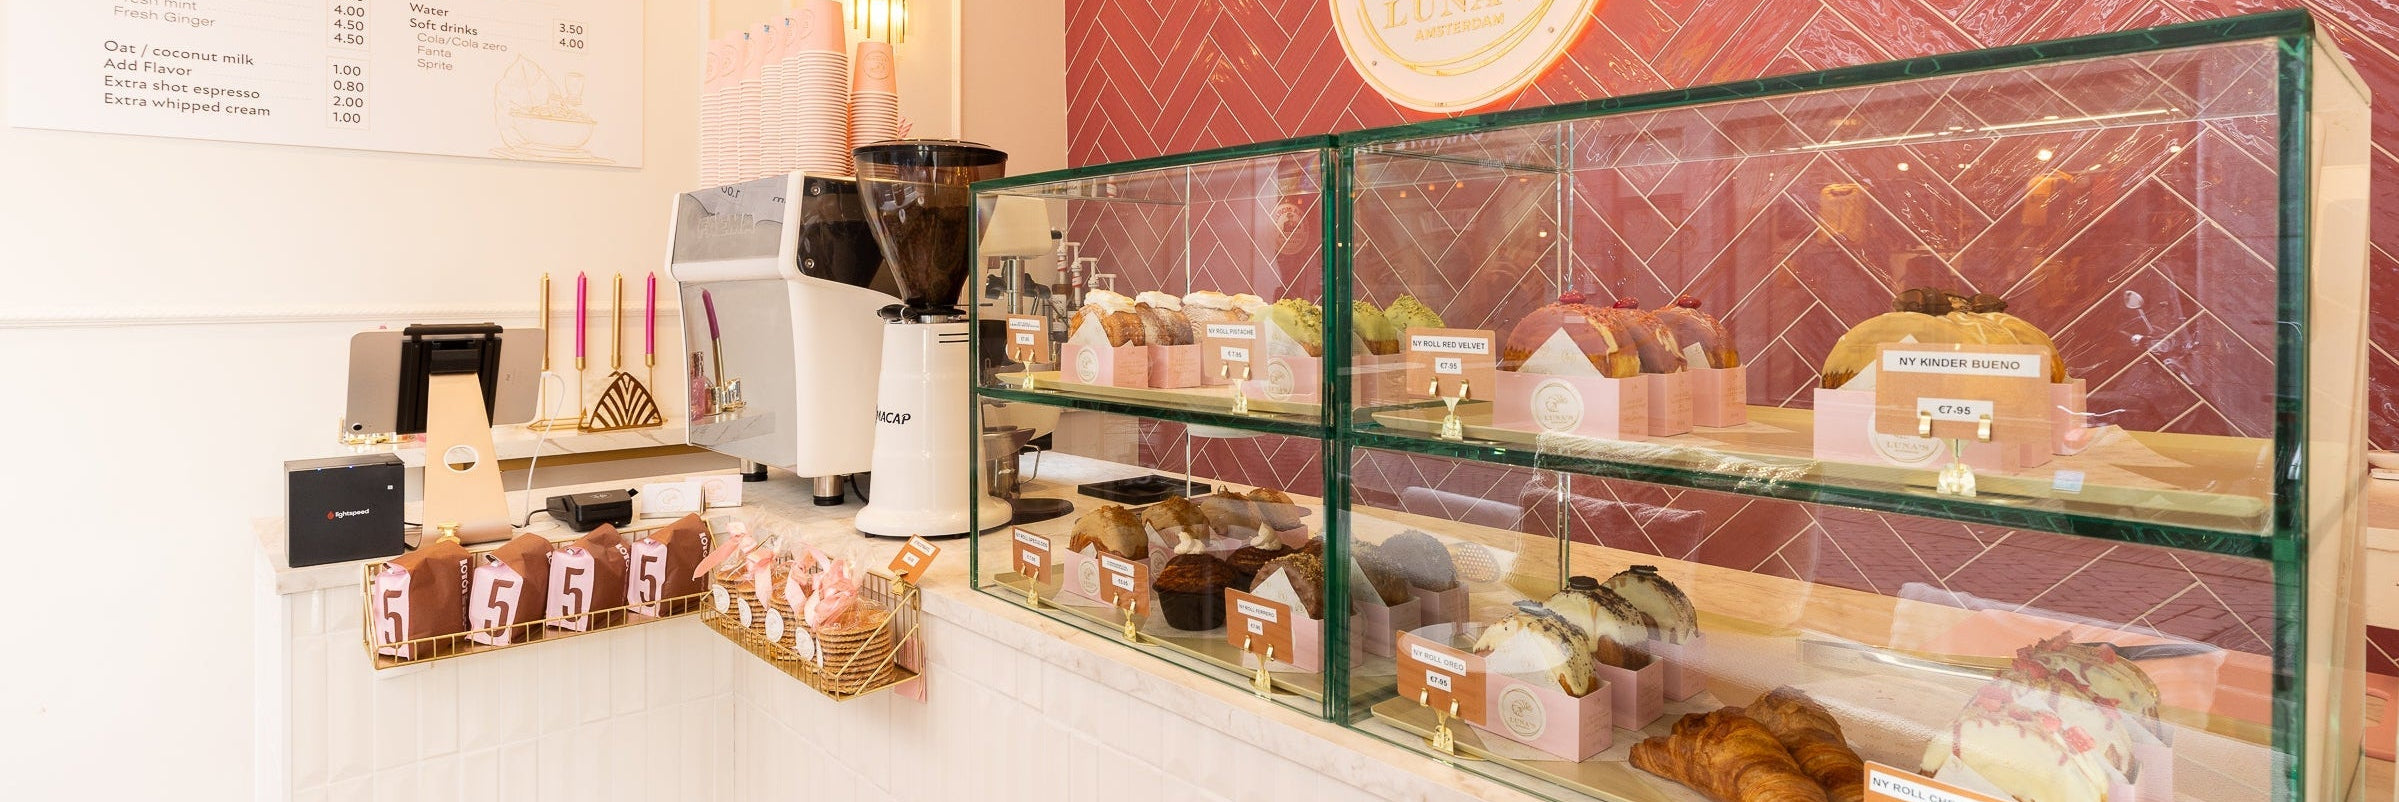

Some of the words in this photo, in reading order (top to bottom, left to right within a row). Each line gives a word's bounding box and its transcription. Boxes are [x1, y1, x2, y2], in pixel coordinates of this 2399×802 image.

[114, 5, 158, 20] Fresh
[164, 11, 216, 28] Ginger
[334, 5, 365, 17] 4.00
[409, 2, 449, 17] Water
[334, 19, 364, 31] 4.50
[409, 17, 437, 31] Soft
[440, 22, 478, 36] drinks
[559, 23, 584, 35] 3.50
[1414, 13, 1505, 41] AMSTERDAM
[334, 33, 364, 45] 4.50
[417, 32, 479, 49] Cola/Cola
[483, 42, 508, 52] zero
[559, 38, 584, 49] 4.00
[104, 40, 136, 54] Oat
[140, 44, 148, 58] /
[152, 47, 218, 62] coconut
[222, 53, 254, 66] milk
[417, 45, 452, 58] Fanta
[104, 58, 138, 71] Add
[144, 61, 192, 76] Flavor
[333, 64, 361, 76] 1.00
[417, 58, 453, 71] Sprite
[104, 75, 147, 90] Extra
[152, 80, 189, 93] shot
[193, 85, 260, 99] espresso
[333, 80, 364, 92] 0.80
[104, 92, 147, 107] Extra
[152, 98, 220, 113] whipped
[225, 105, 271, 116] cream
[333, 95, 364, 107] 2.00
[333, 112, 361, 123] 1.00
[1424, 340, 1441, 348] ROLL
[1899, 357, 1916, 367] NY
[1920, 357, 1968, 368] KINDER
[1972, 360, 2021, 370] BUENO
[335, 508, 370, 519] lightspeed
[639, 555, 658, 608] 5
[562, 567, 585, 623] 5
[484, 578, 515, 638] 5
[383, 589, 404, 648] 5
[1413, 649, 1422, 657] NY
[1424, 652, 1442, 663] ROLL
[1443, 659, 1464, 671] OREO
[1873, 777, 1889, 789] NY
[1893, 783, 1925, 800] ROLL
